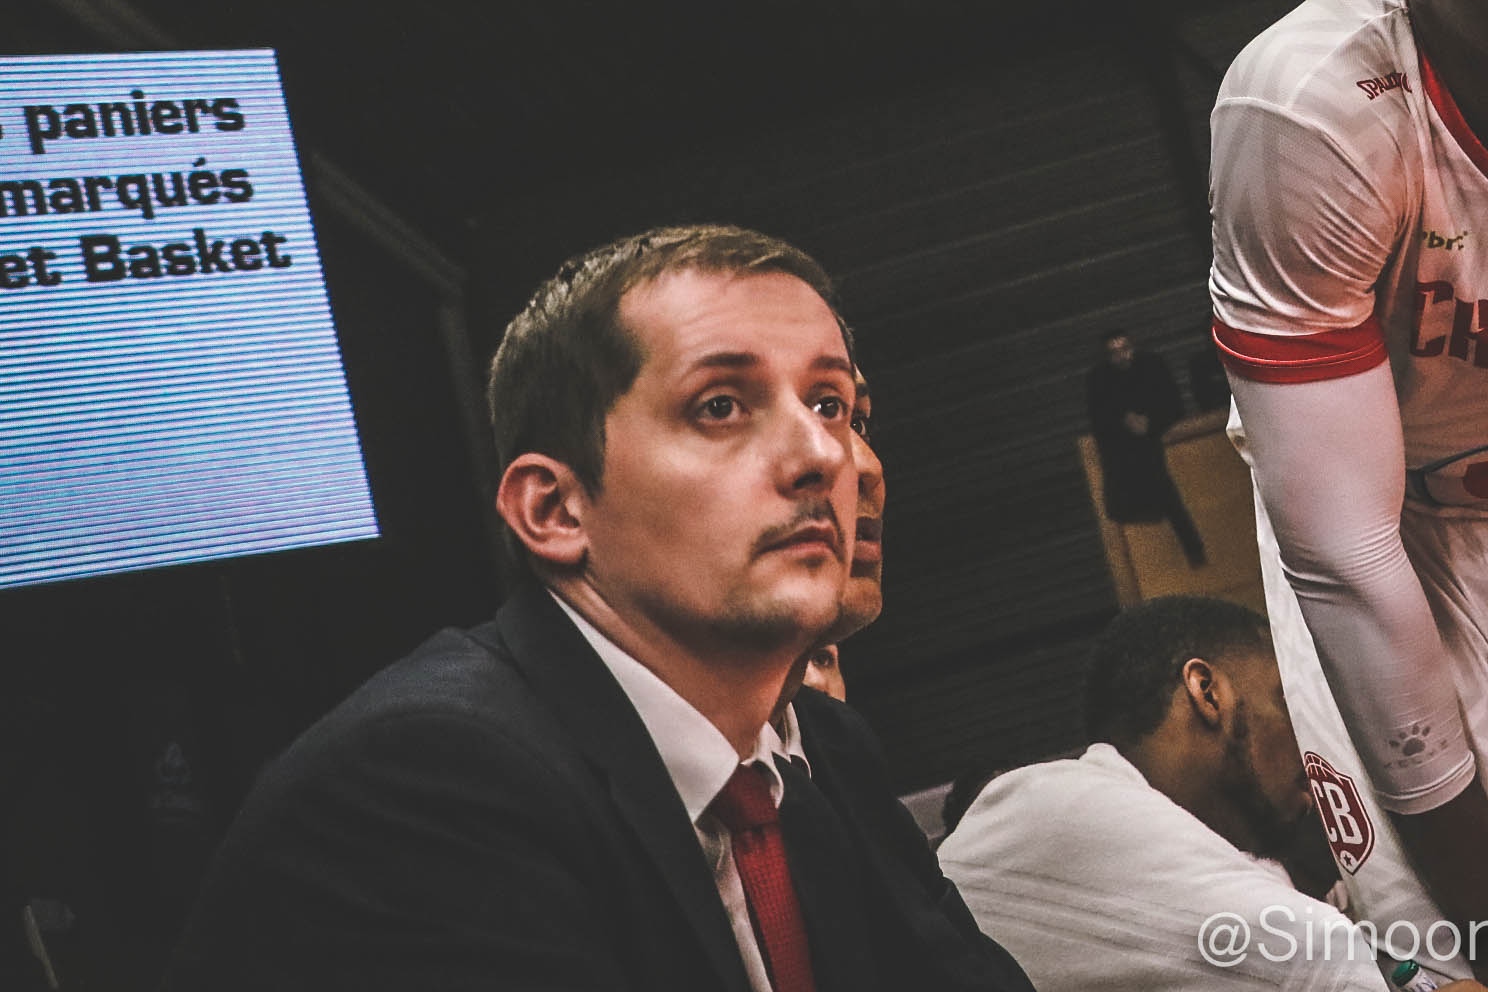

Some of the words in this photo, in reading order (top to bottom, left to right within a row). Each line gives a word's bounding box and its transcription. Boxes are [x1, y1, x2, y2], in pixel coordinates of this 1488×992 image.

[24, 90, 245, 154] paniers
[0, 157, 253, 221] marqués
[80, 229, 292, 284] Basket
